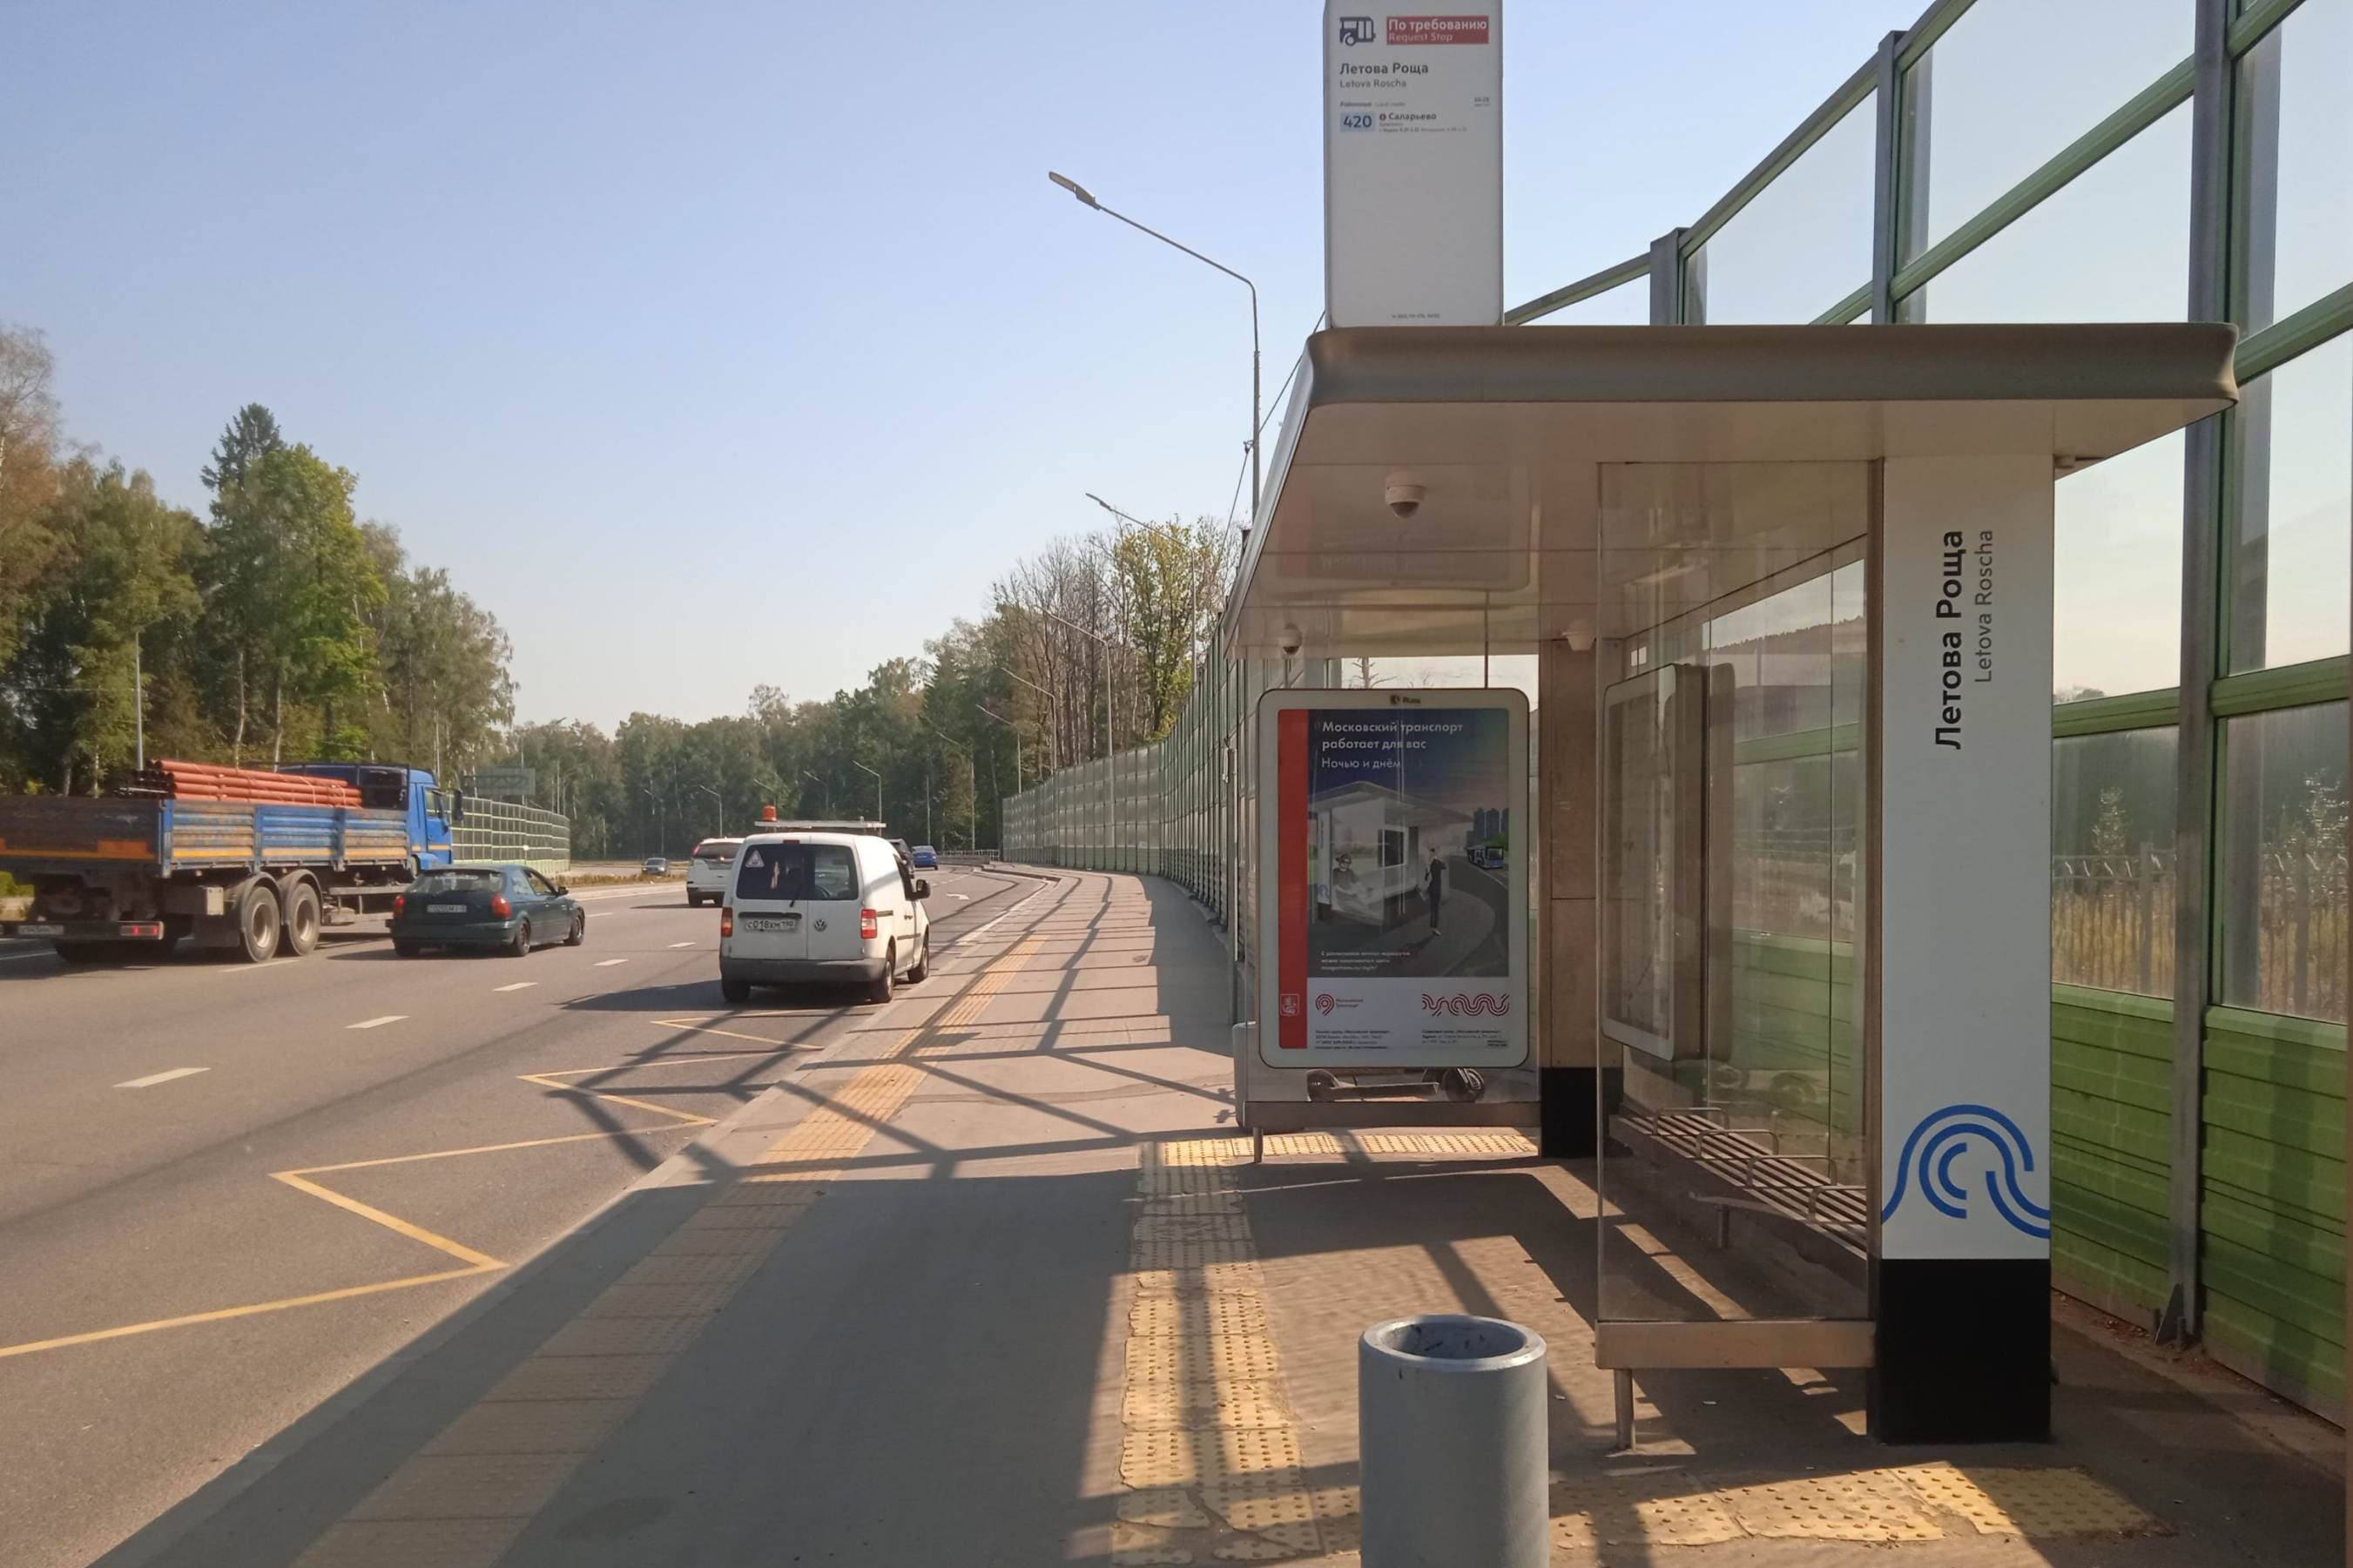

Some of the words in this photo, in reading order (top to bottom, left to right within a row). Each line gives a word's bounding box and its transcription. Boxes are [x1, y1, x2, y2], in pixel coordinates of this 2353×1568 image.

[1389, 19, 1407, 30] По
[1411, 18, 1487, 32] требованию
[1389, 33, 1428, 42] Request
[1431, 33, 1453, 42] Stop
[1339, 63, 1388, 74] Летова
[1392, 63, 1429, 75] Роща
[1373, 79, 1406, 88] Roscha
[1344, 115, 1372, 128] 420
[1388, 112, 1437, 121] Саларьево
[1974, 530, 1992, 604] Roscha
[1936, 531, 1966, 618] Роща
[1974, 613, 1992, 682] Letova
[1935, 632, 1962, 750] Летова
[1322, 722, 1398, 732] Московский
[1401, 723, 1464, 735] транспорт
[1322, 738, 1379, 751] работает
[1382, 741, 1403, 750] для
[1322, 758, 1359, 768] Ночью
[1372, 759, 1400, 769] днём
